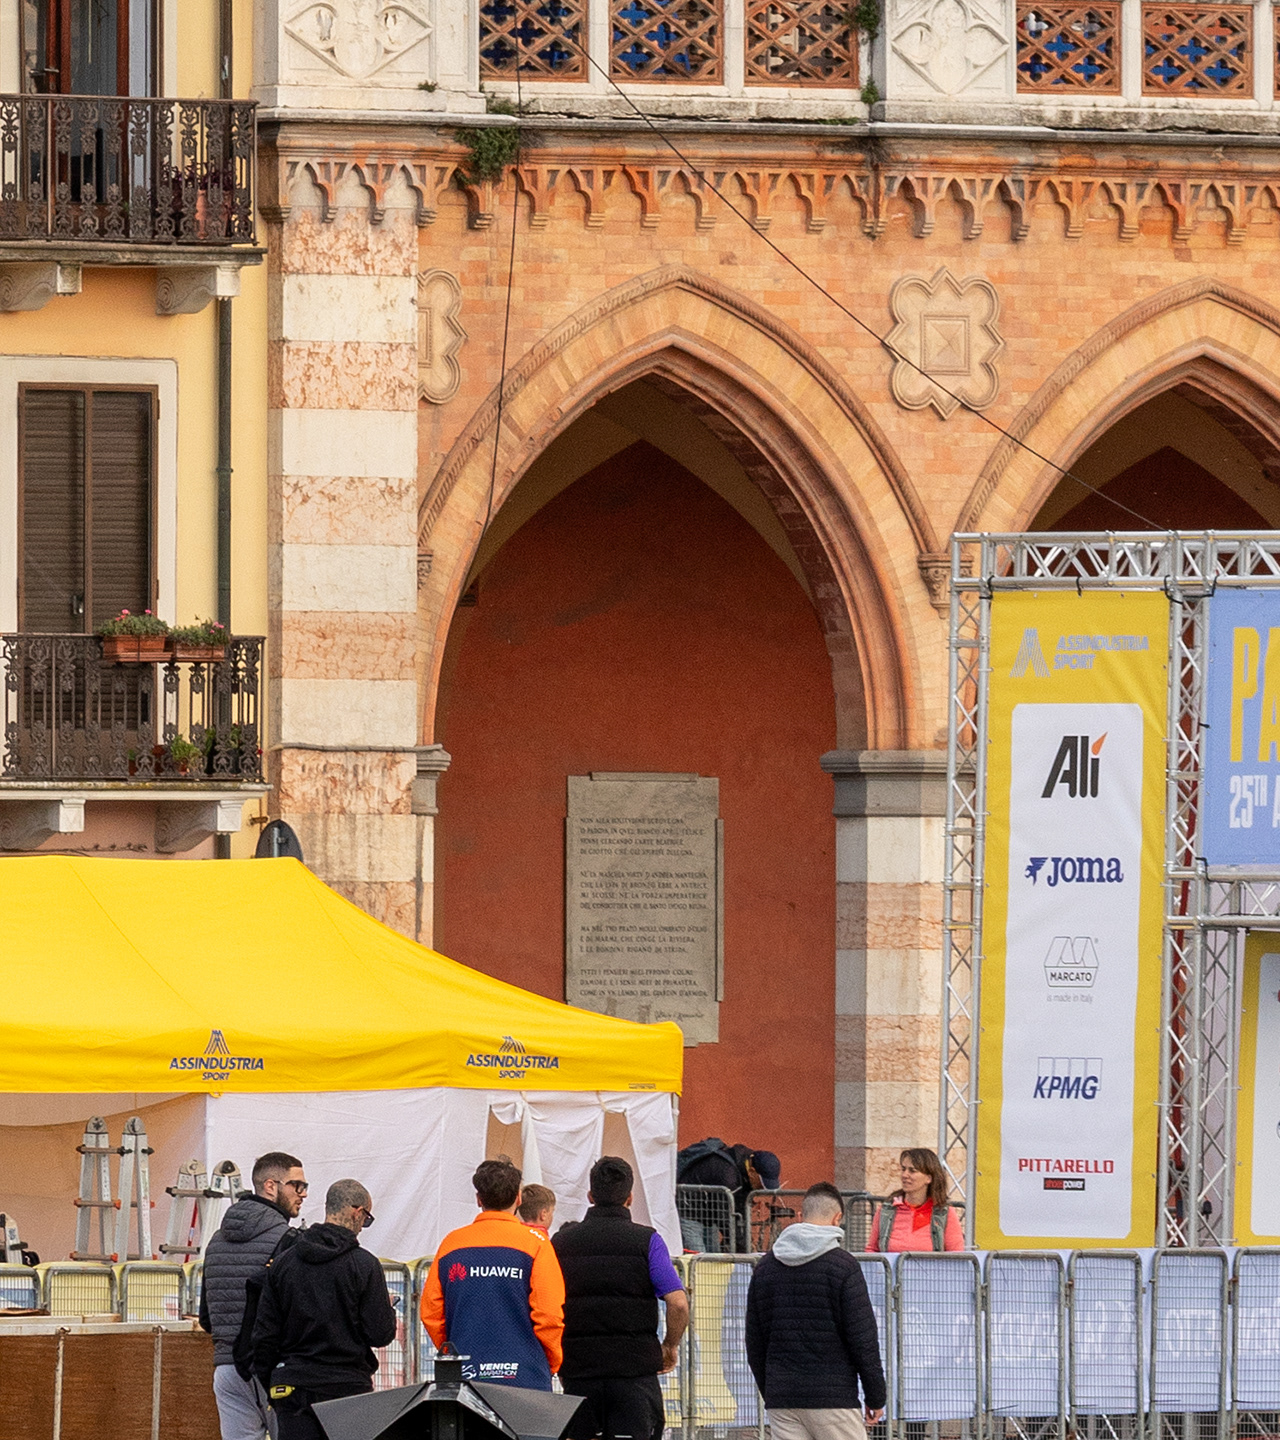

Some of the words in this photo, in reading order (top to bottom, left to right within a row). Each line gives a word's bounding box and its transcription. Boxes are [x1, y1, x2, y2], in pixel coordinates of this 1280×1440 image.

[1056, 634, 1150, 651] ASSINDUSTRIA
[1053, 653, 1096, 669] SPORT
[1049, 971, 1092, 983] MARCATO
[1054, 994, 1071, 1003] made
[1080, 994, 1094, 1005] Italy
[169, 1057, 265, 1070] ASSINDUSTRIA
[466, 1054, 559, 1069] ASSINDUSTRIA
[202, 1072, 231, 1081] SPORT
[498, 1070, 526, 1079] SPORT
[1033, 1075, 1099, 1100] KPMG
[1018, 1158, 1114, 1174] PITTARELLO
[470, 1266, 524, 1280] HUAWEI
[479, 1363, 519, 1371] VENICE
